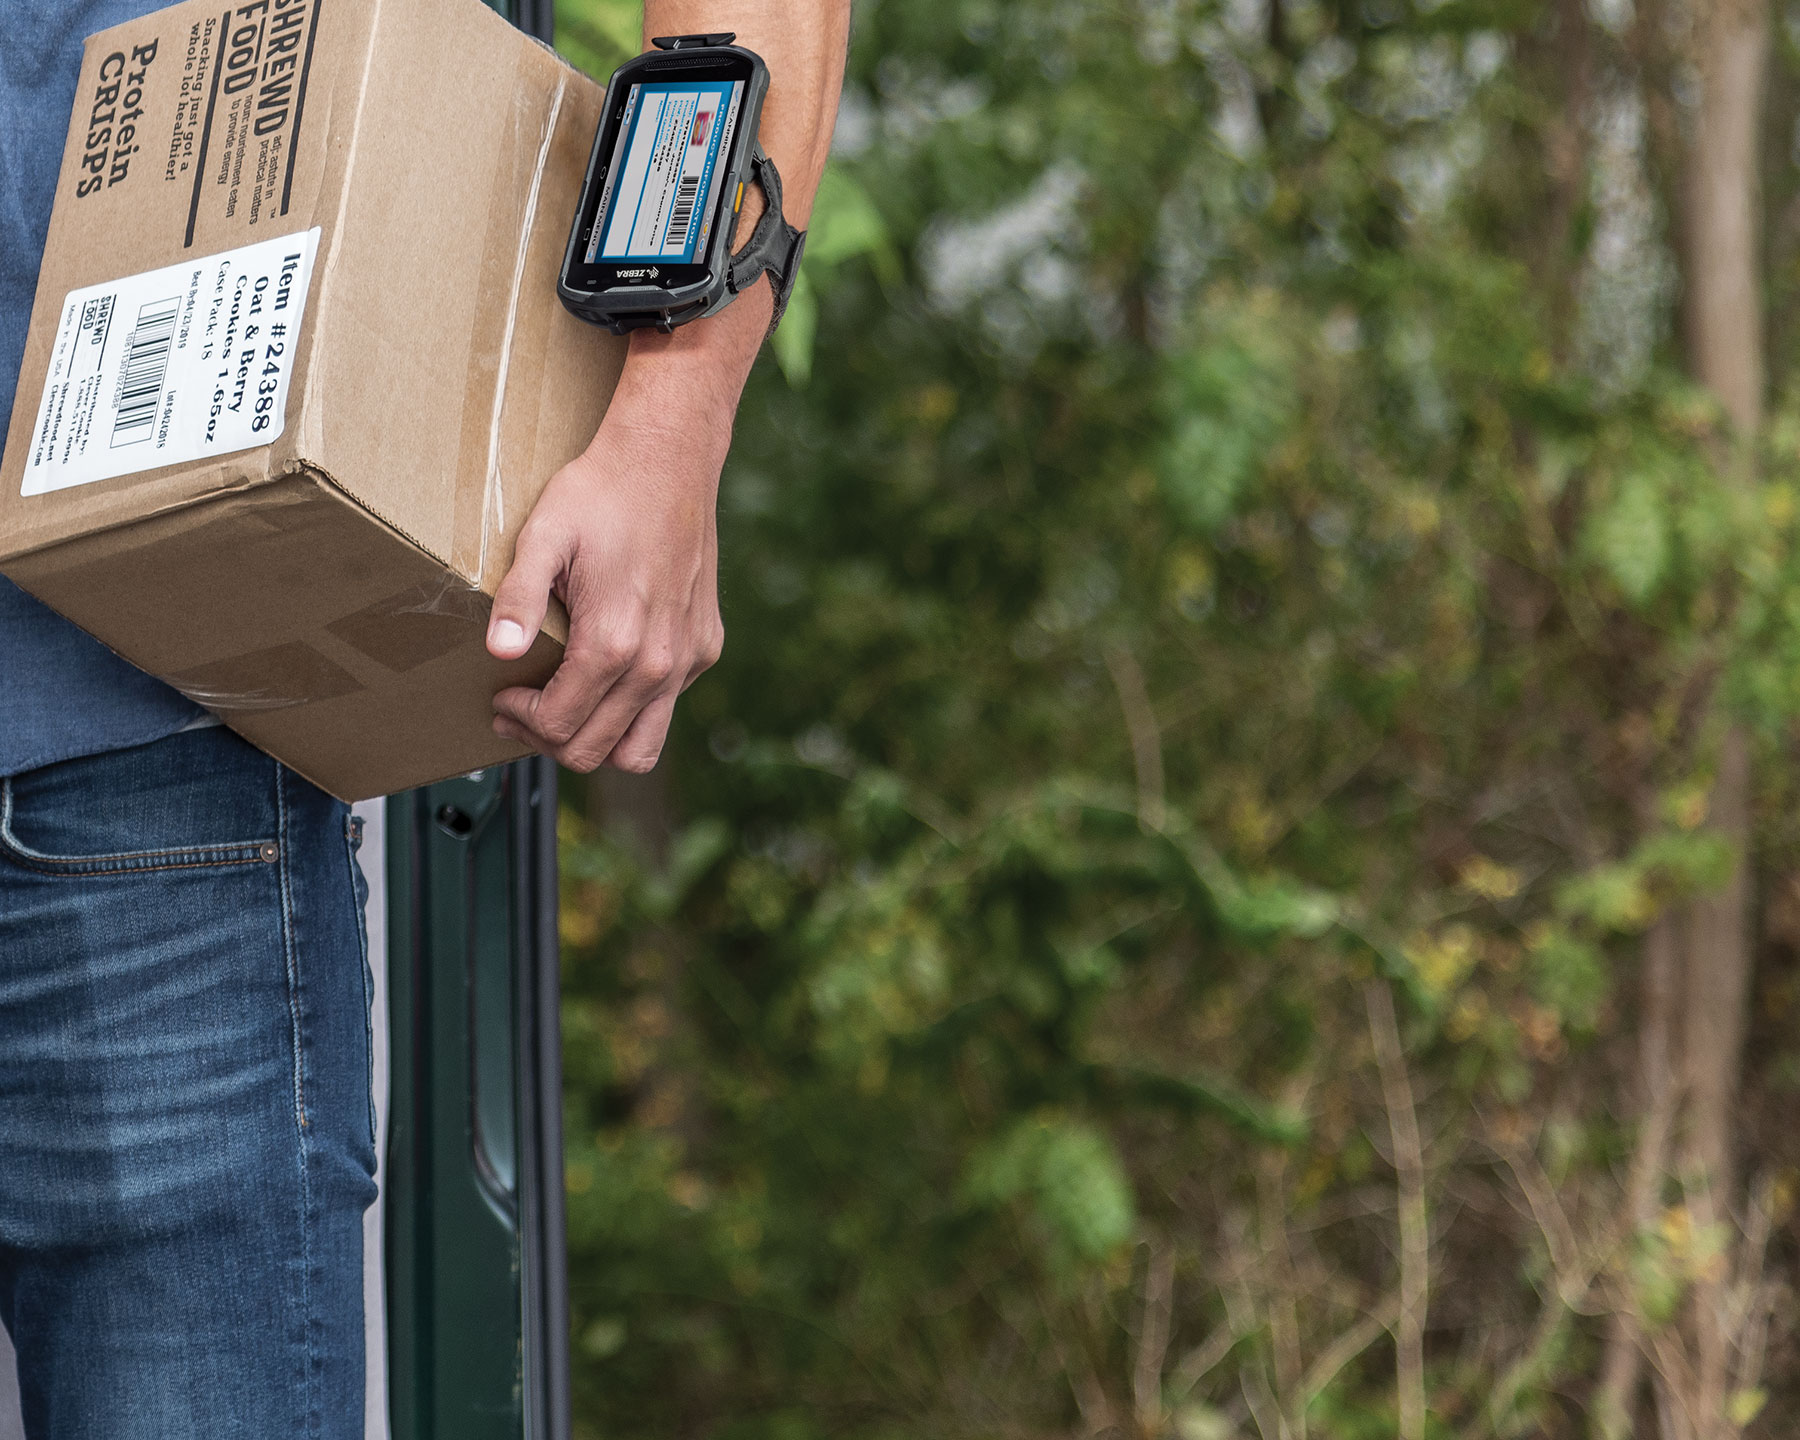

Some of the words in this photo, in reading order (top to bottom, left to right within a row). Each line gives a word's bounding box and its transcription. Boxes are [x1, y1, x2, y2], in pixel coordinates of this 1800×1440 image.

[184, 22, 201, 71] whole
[191, 18, 216, 91] Snacking
[224, 0, 269, 94] FOOD
[179, 75, 194, 98] lot
[230, 97, 243, 111] to
[77, 52, 125, 197] CRISPS
[108, 39, 158, 186] Protein
[187, 97, 203, 127] just
[242, 94, 253, 123] noun:
[165, 102, 189, 181] healthier!
[182, 131, 194, 157] got
[225, 112, 238, 149] provide
[269, 134, 283, 155] adj:
[709, 103, 725, 157] PRODUCT
[720, 106, 736, 156] SCANNING
[179, 161, 190, 173] a
[217, 151, 232, 185] energy
[231, 124, 248, 187] nourishment
[256, 139, 272, 183] practical
[266, 155, 278, 187] astute
[226, 189, 238, 218] eaten
[249, 185, 262, 225] matters
[264, 187, 277, 201] in
[599, 185, 612, 214] MAIN
[688, 161, 711, 244] INFORMATION
[590, 214, 604, 247] MENU
[216, 260, 231, 293] Case
[274, 254, 301, 310] Item
[616, 269, 646, 279] ZEBRA
[83, 299, 99, 330] FOOD
[249, 276, 269, 315] Oat
[91, 296, 112, 345] SHREWD
[206, 297, 223, 336] Pack:
[222, 275, 247, 359] Cookies
[245, 324, 259, 340] &
[201, 341, 215, 361] 18
[83, 376, 94, 406] Clever
[228, 349, 255, 412] Berry
[252, 324, 286, 432] #24388
[47, 382, 69, 461] Shrewdfood.net
[84, 374, 102, 436] Distributed
[206, 369, 229, 442] 1.65oz
[34, 384, 59, 466] Clevercookie.com
[75, 410, 87, 443] Cookie
